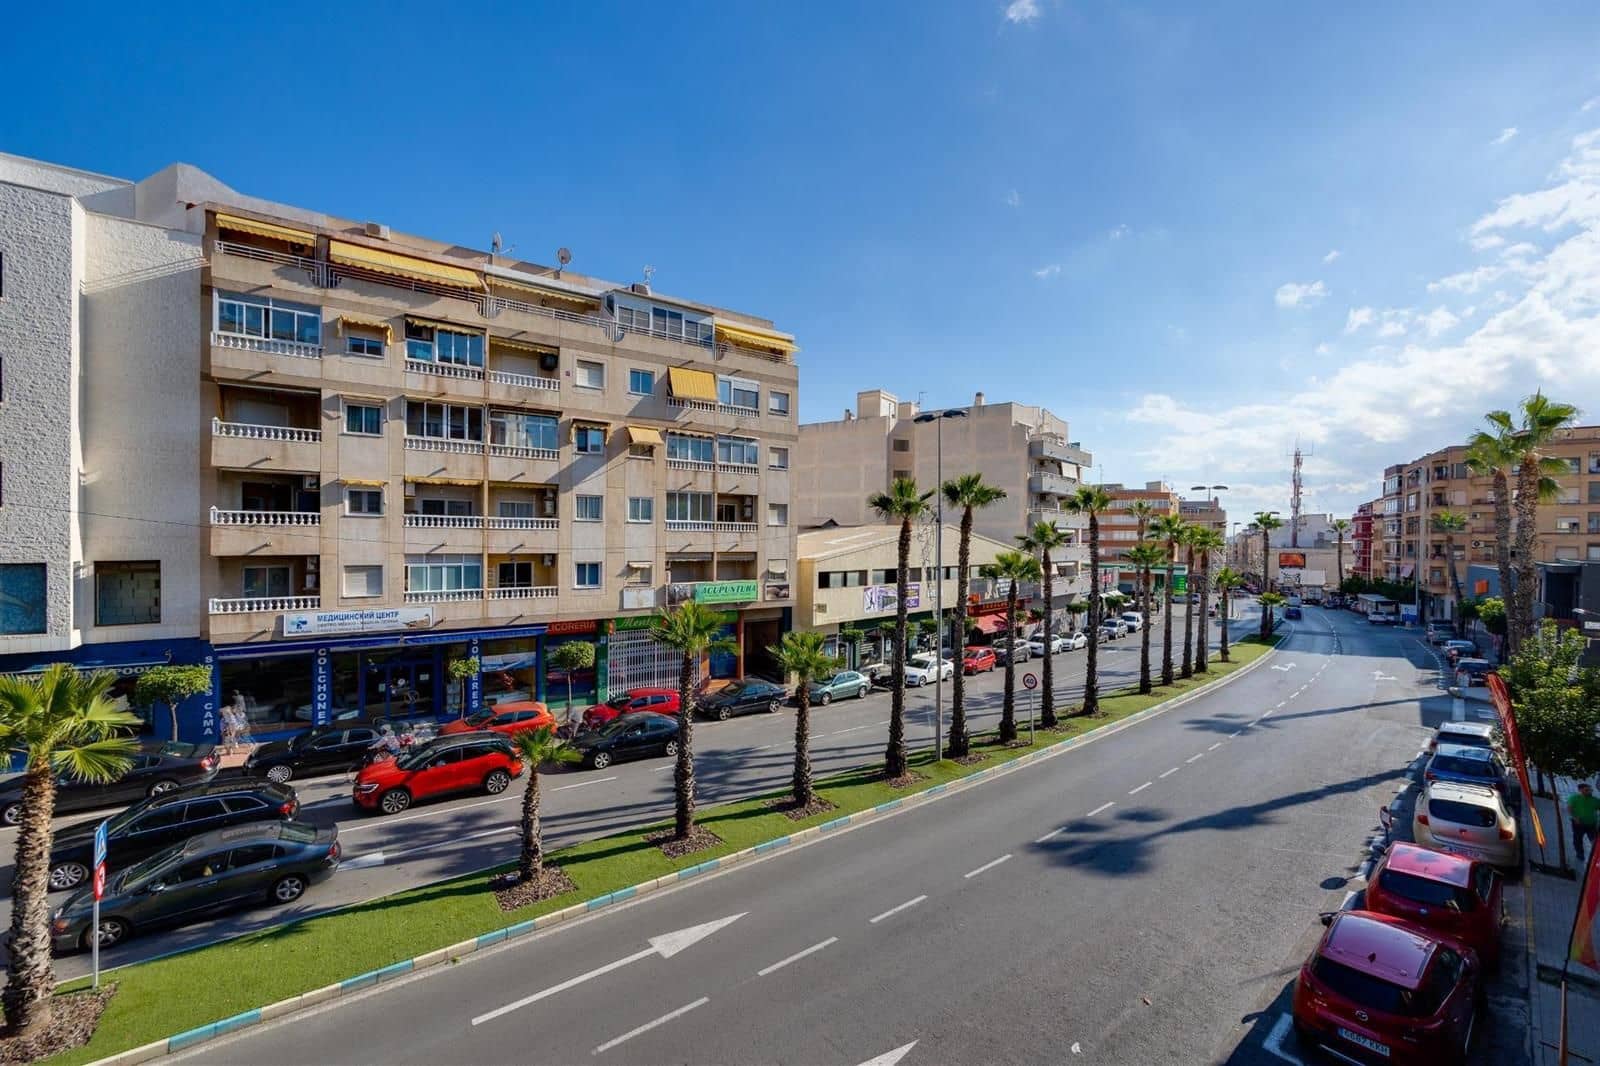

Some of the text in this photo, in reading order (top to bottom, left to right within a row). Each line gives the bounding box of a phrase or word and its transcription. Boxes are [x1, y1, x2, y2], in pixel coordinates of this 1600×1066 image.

[703, 584, 756, 595] ACUPUNTURA
[317, 611, 375, 622] МЕДИЦИНСКИЙ
[376, 610, 400, 620] ЦЕНТР
[471, 637, 480, 708] SOERES
[203, 702, 213, 735] CAMA
